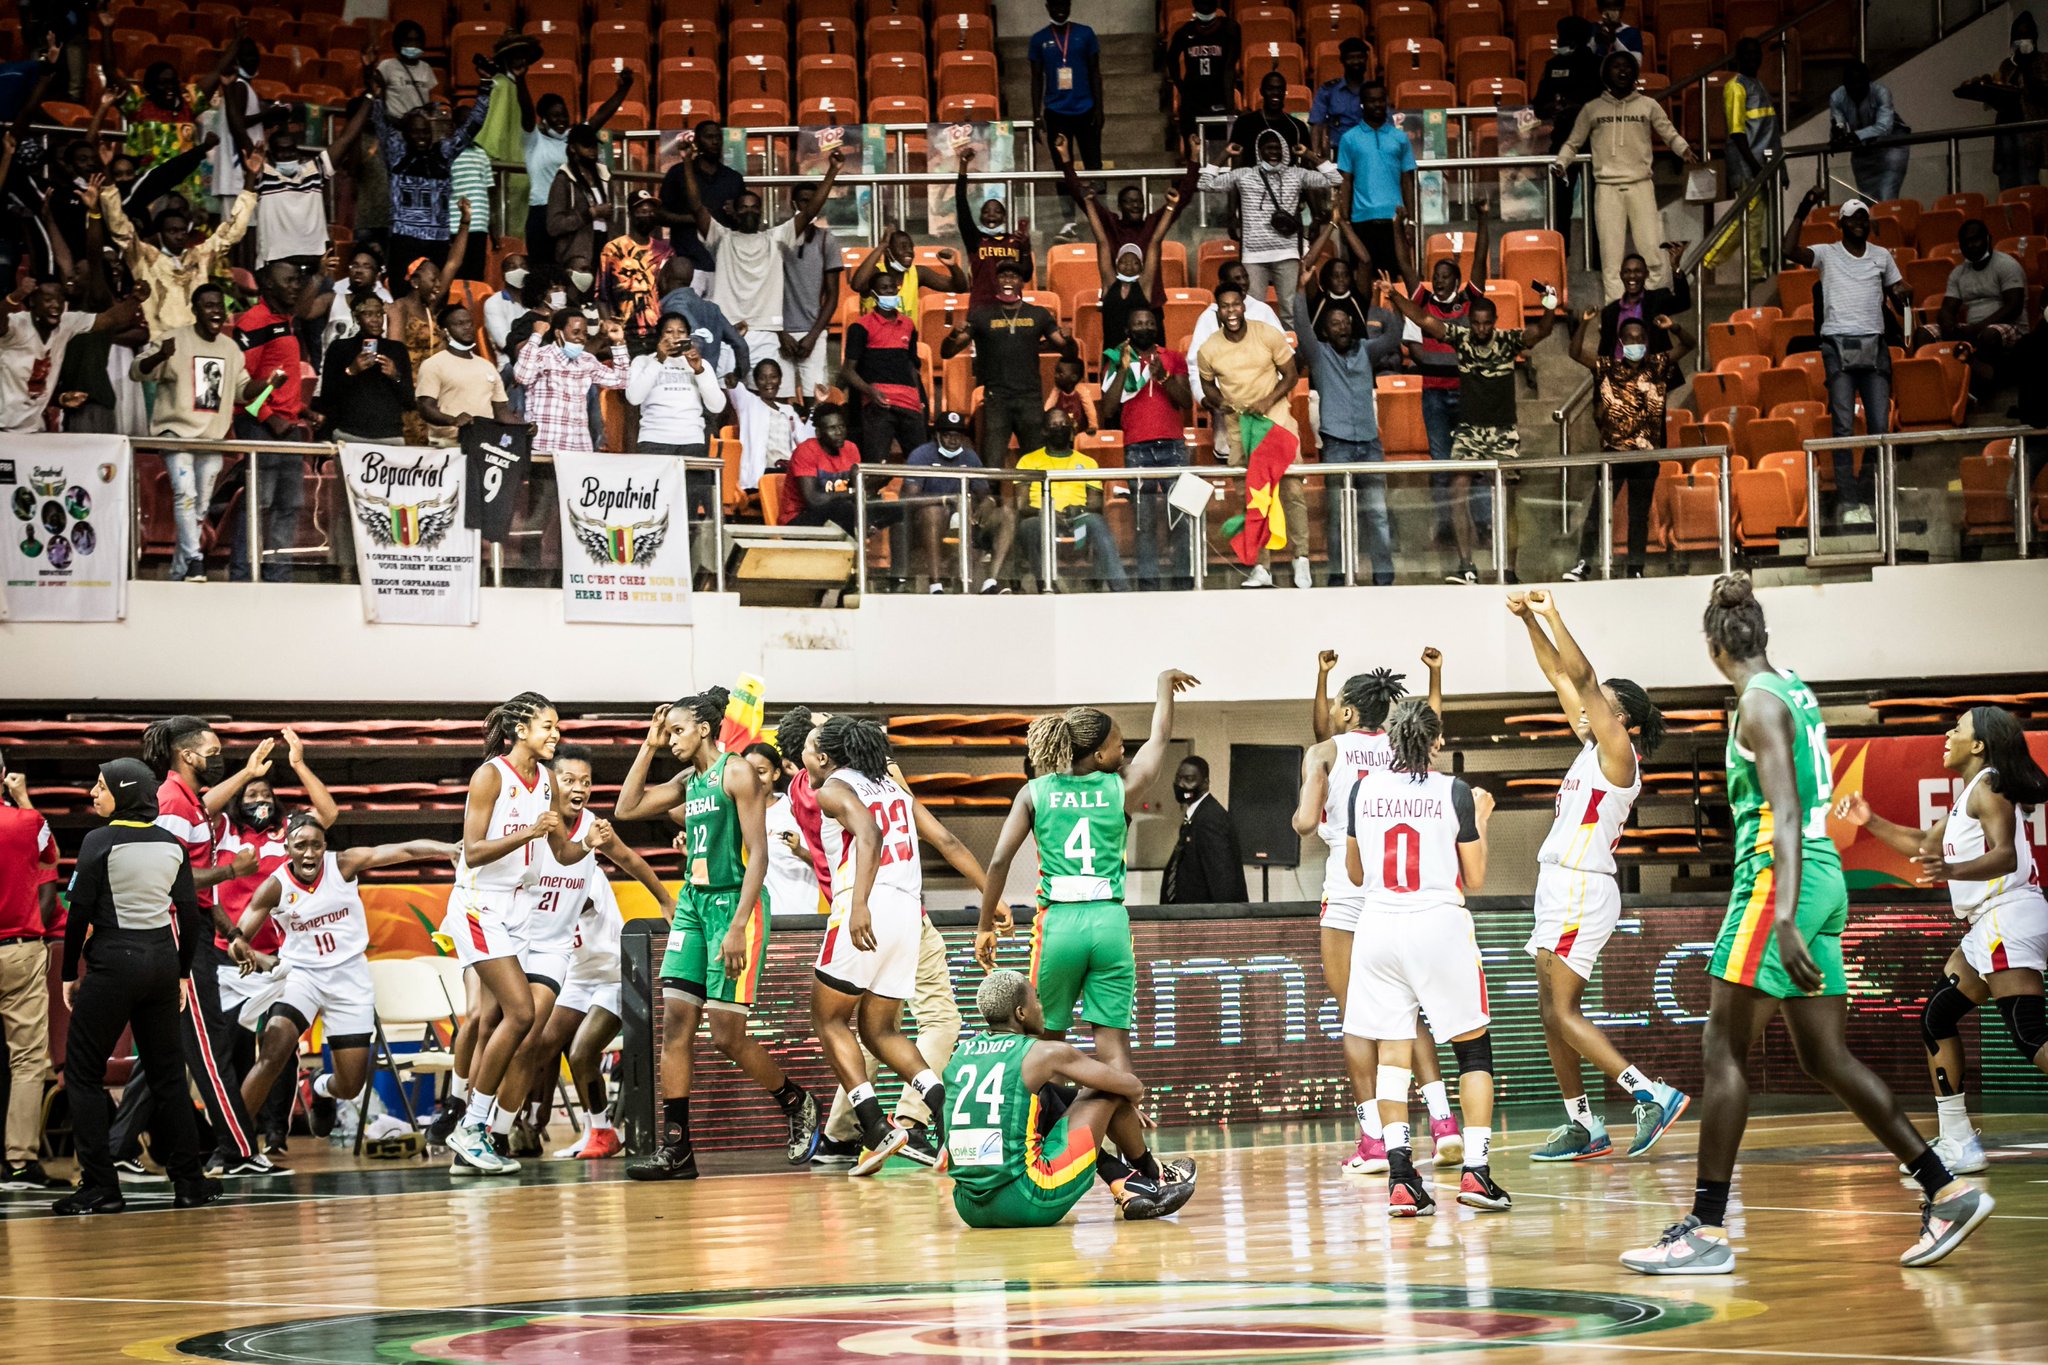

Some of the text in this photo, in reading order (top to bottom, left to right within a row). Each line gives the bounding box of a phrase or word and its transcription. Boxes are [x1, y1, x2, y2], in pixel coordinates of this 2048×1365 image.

[1200, 58, 1210, 75] 13
[815, 127, 845, 147] TOP
[943, 124, 973, 144] TOP
[361, 451, 449, 498] Bepatriot
[483, 466, 503, 503] 9
[580, 476, 660, 520] Bepatriot
[570, 574, 584, 584] ICI
[587, 575, 615, 585] C'EST
[620, 576, 646, 586] CHEZ
[575, 590, 602, 600] HERE
[605, 591, 615, 601] IT
[619, 591, 629, 601] IS
[632, 592, 658, 602] WITH
[1049, 790, 1110, 808] FALL
[1362, 798, 1443, 820] ALEXANDRA
[693, 824, 707, 855] 12
[1064, 817, 1096, 875] 4
[1383, 823, 1420, 894] 0
[537, 891, 560, 912] 21
[314, 932, 336, 956] 10
[1621, 1071, 1639, 1088] PEAK
[952, 1062, 1006, 1125] 24
